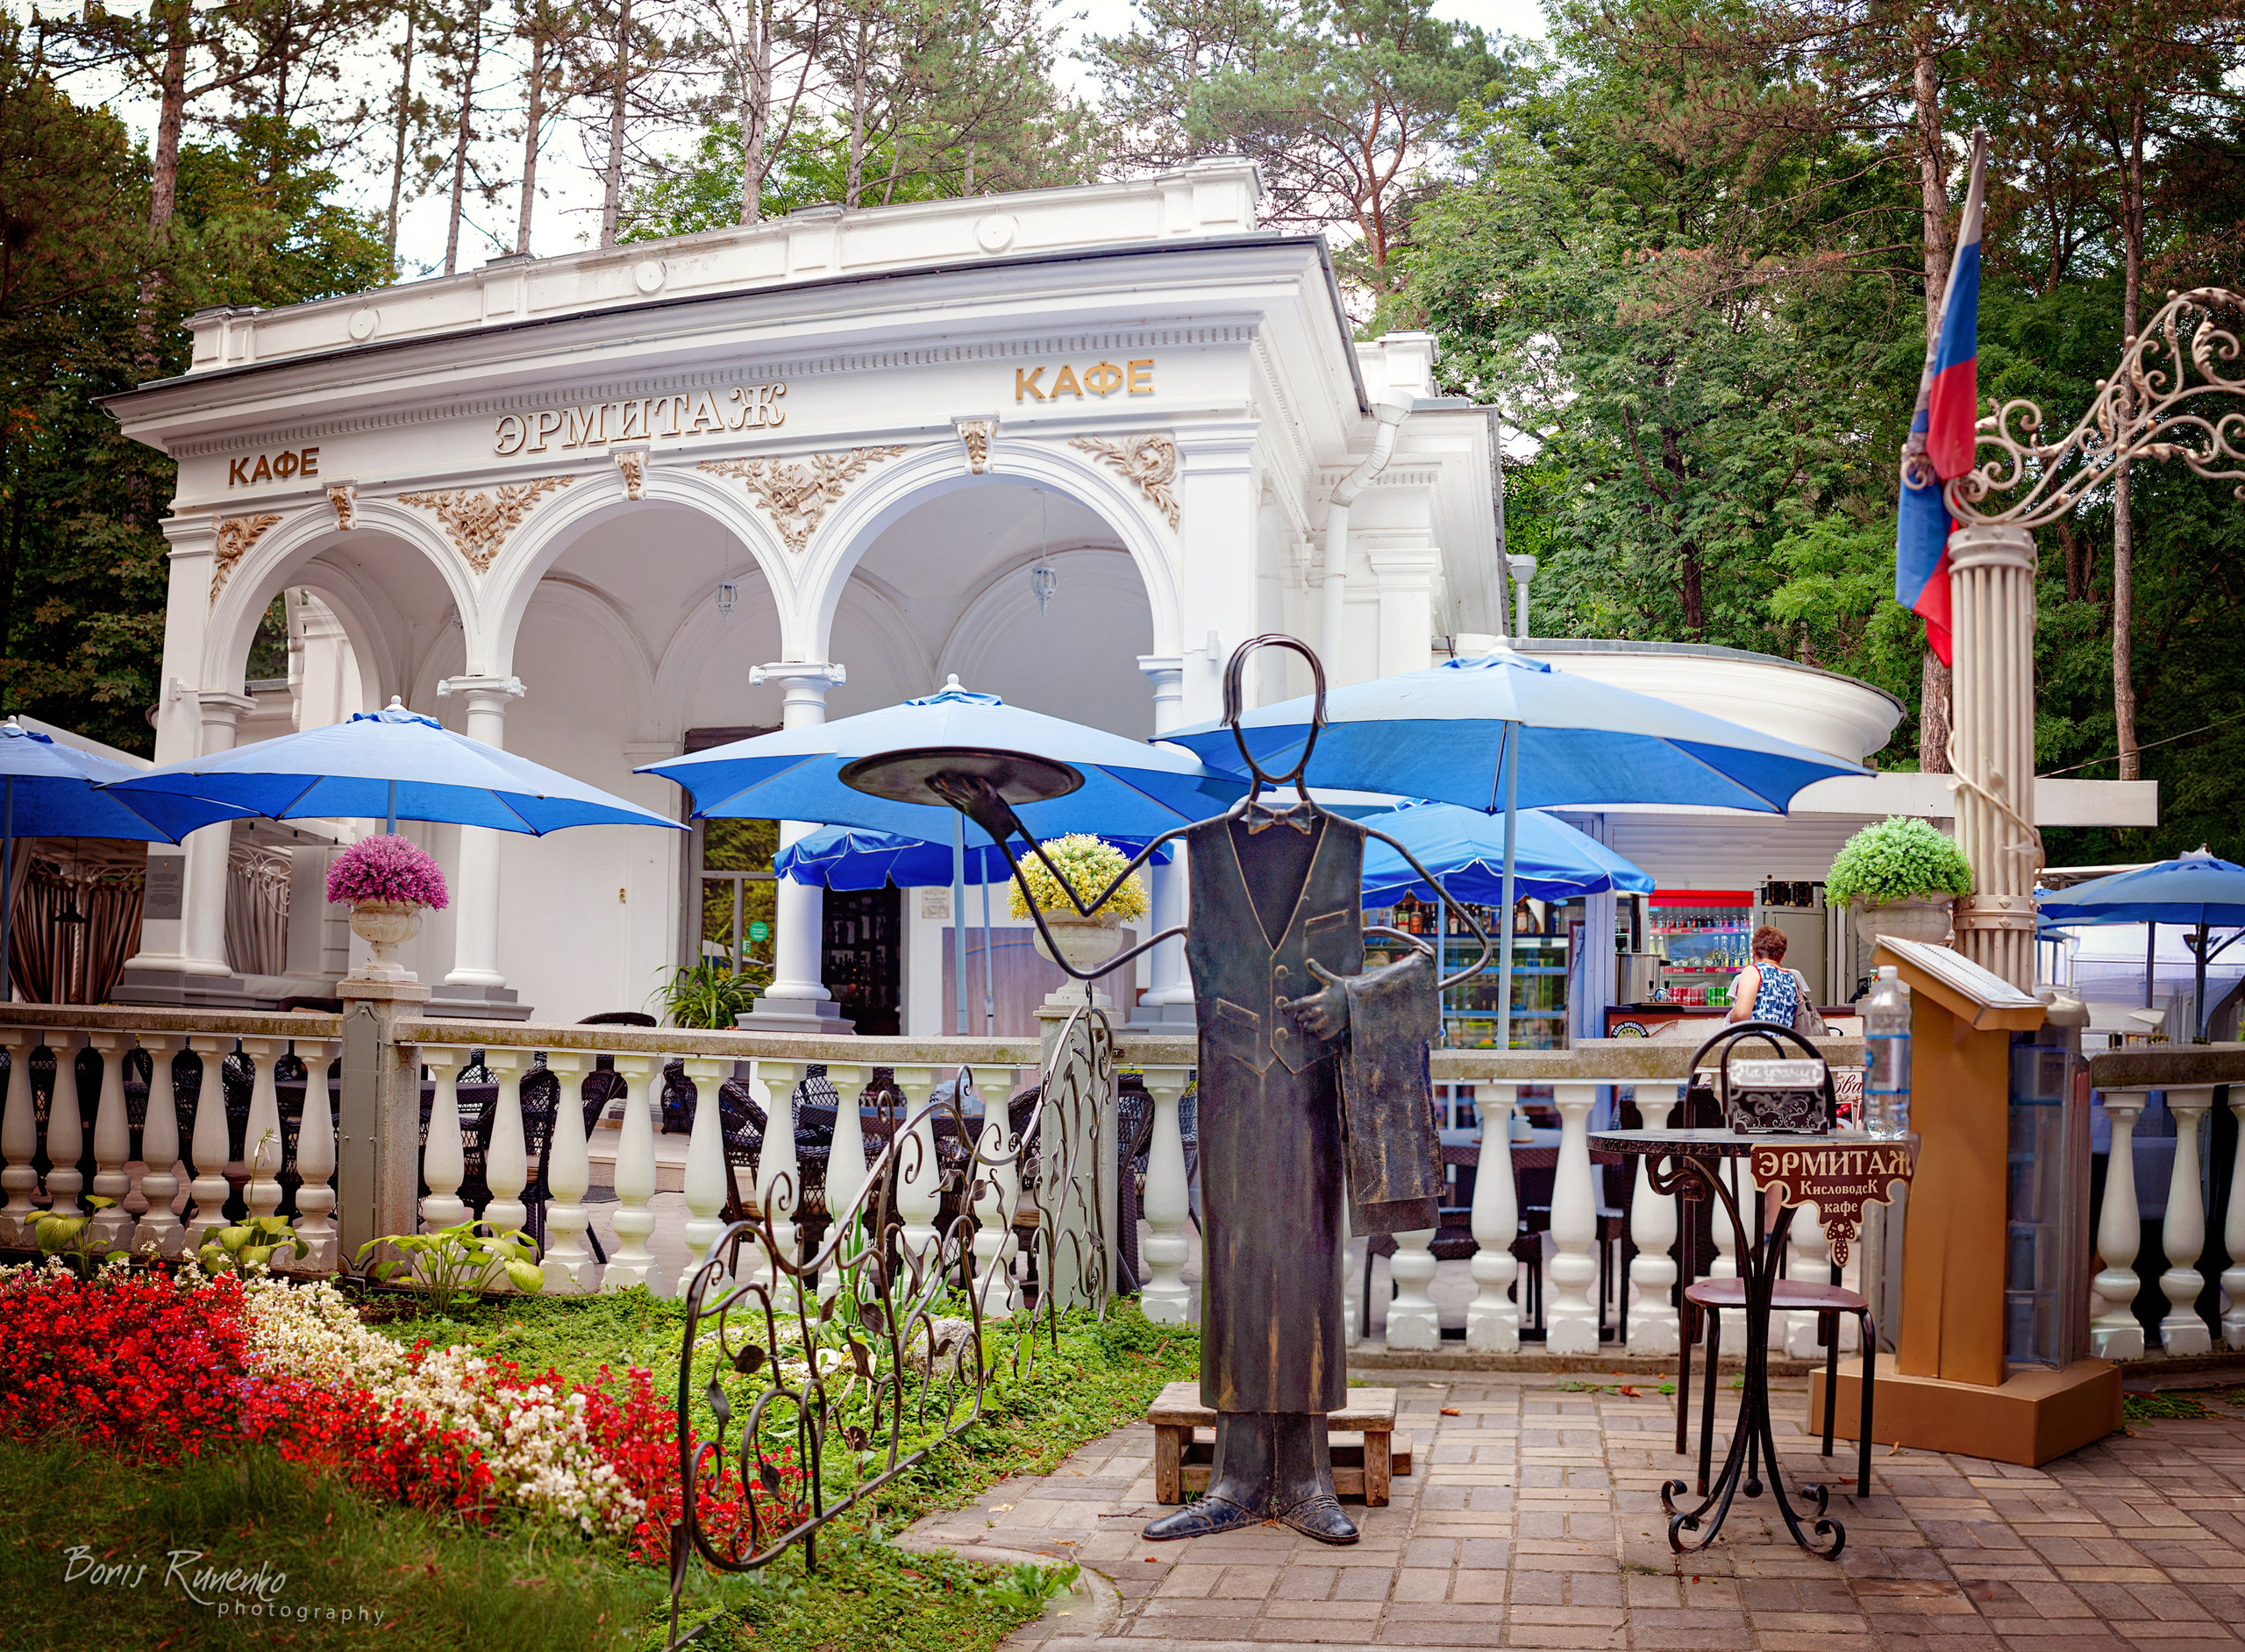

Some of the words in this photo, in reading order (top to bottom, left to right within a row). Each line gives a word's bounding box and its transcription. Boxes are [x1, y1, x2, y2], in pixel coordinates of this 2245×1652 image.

[1016, 359, 1155, 402] КАФЕ
[493, 382, 787, 455] ЭРМИТАЖ
[229, 446, 319, 486] КАФЕ
[1824, 1200, 1858, 1216] кафе
